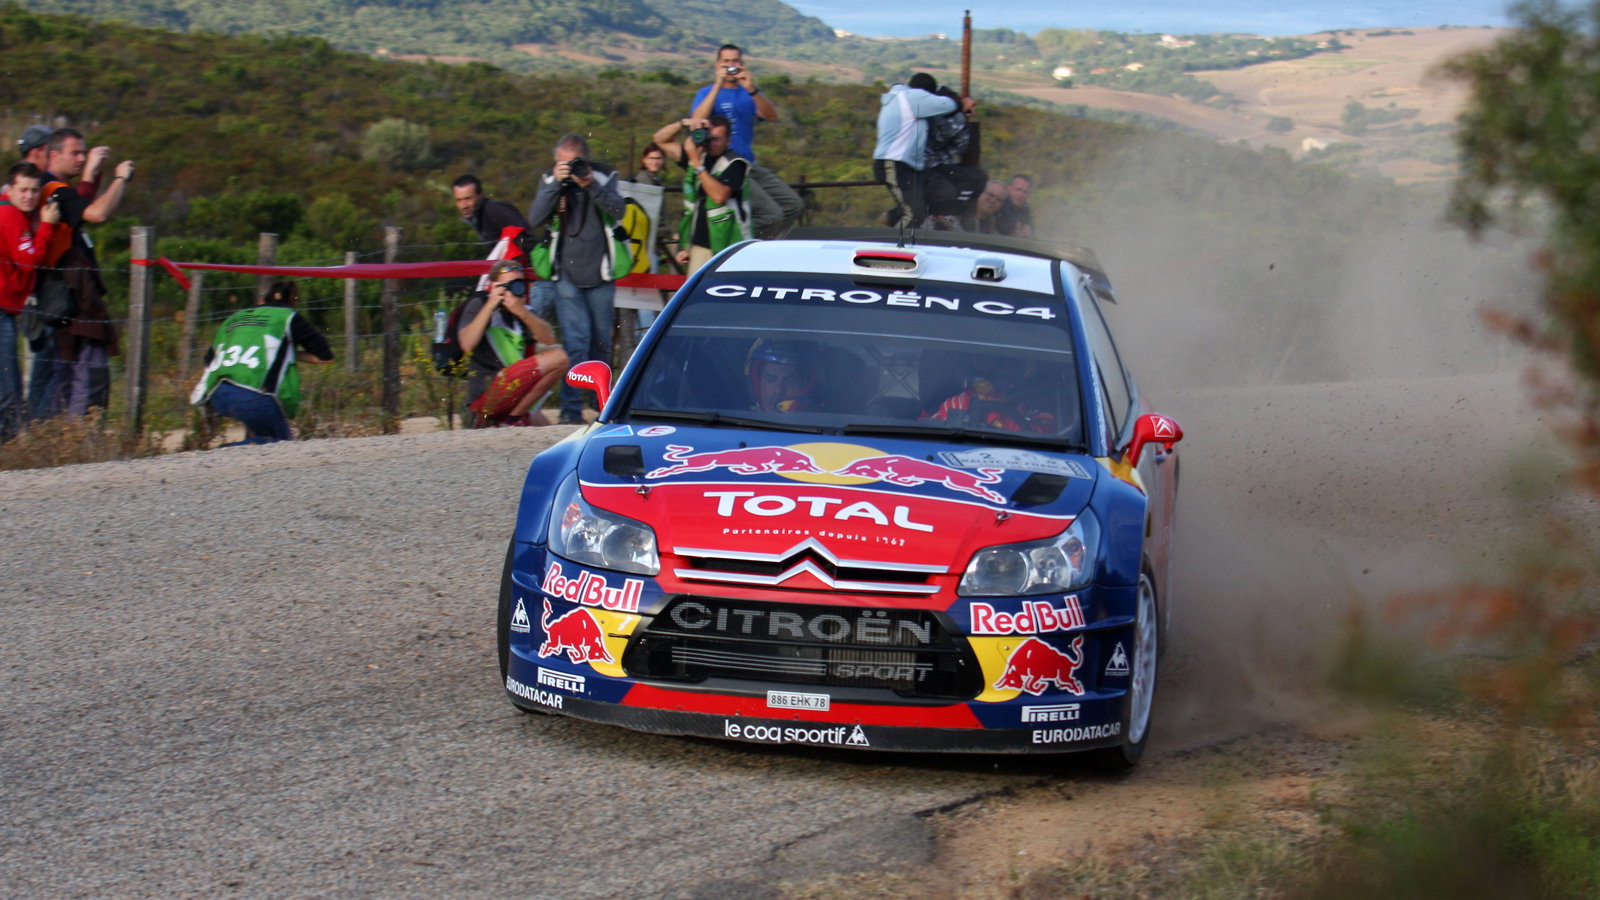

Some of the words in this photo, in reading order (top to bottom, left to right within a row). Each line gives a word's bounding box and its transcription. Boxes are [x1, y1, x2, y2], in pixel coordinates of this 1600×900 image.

[705, 284, 962, 312] CITROËN
[972, 299, 1057, 320] C4
[567, 371, 595, 384] TOTAL
[704, 490, 934, 533] TOTAL
[723, 527, 810, 536] Partenaires
[819, 530, 867, 543] depuis
[543, 563, 588, 603] Red
[582, 574, 642, 612] Bull
[669, 601, 932, 645] CITROËN
[971, 602, 1036, 633] Red
[1034, 595, 1085, 633] Bull
[537, 667, 586, 693] PIRELLI
[834, 664, 933, 683] SPORT
[506, 675, 563, 709] EURODATACAR
[770, 694, 788, 706] 886
[790, 695, 811, 707] EHK
[813, 696, 826, 708] 78
[1021, 703, 1081, 723] PIRELLI
[725, 720, 741, 737] le
[743, 724, 784, 743] coq
[785, 725, 846, 744] sportif
[1032, 722, 1121, 744] EURODATACAR
